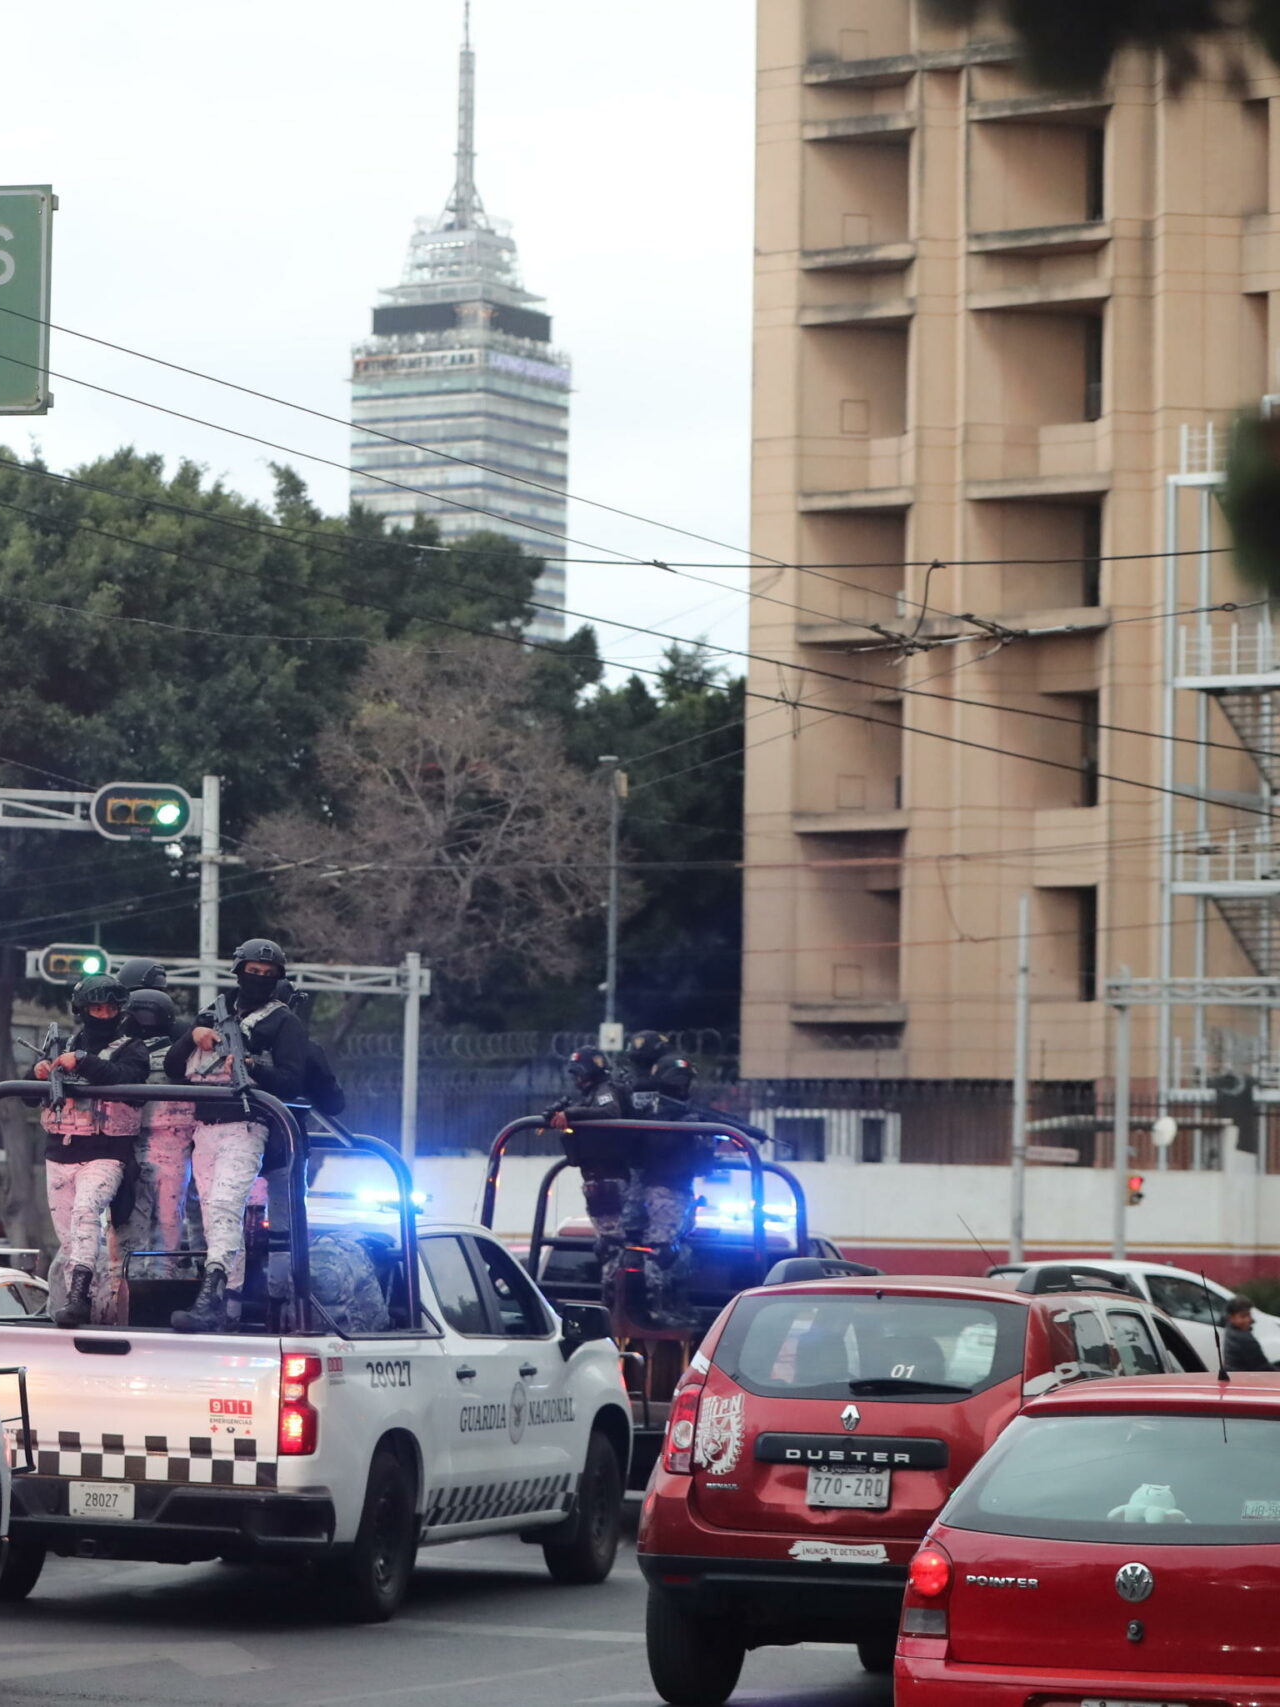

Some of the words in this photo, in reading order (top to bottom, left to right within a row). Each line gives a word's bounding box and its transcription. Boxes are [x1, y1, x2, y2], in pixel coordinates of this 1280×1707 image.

[366, 1360, 412, 1388] 28027
[891, 1364, 915, 1378] 01
[211, 1400, 251, 1413] 911
[460, 1403, 506, 1432] GUARDIA
[528, 1397, 575, 1426] NACIONAL
[785, 1449, 911, 1463] DUSTER
[85, 1492, 118, 1508] 28027
[966, 1575, 1039, 1588] POINTER
